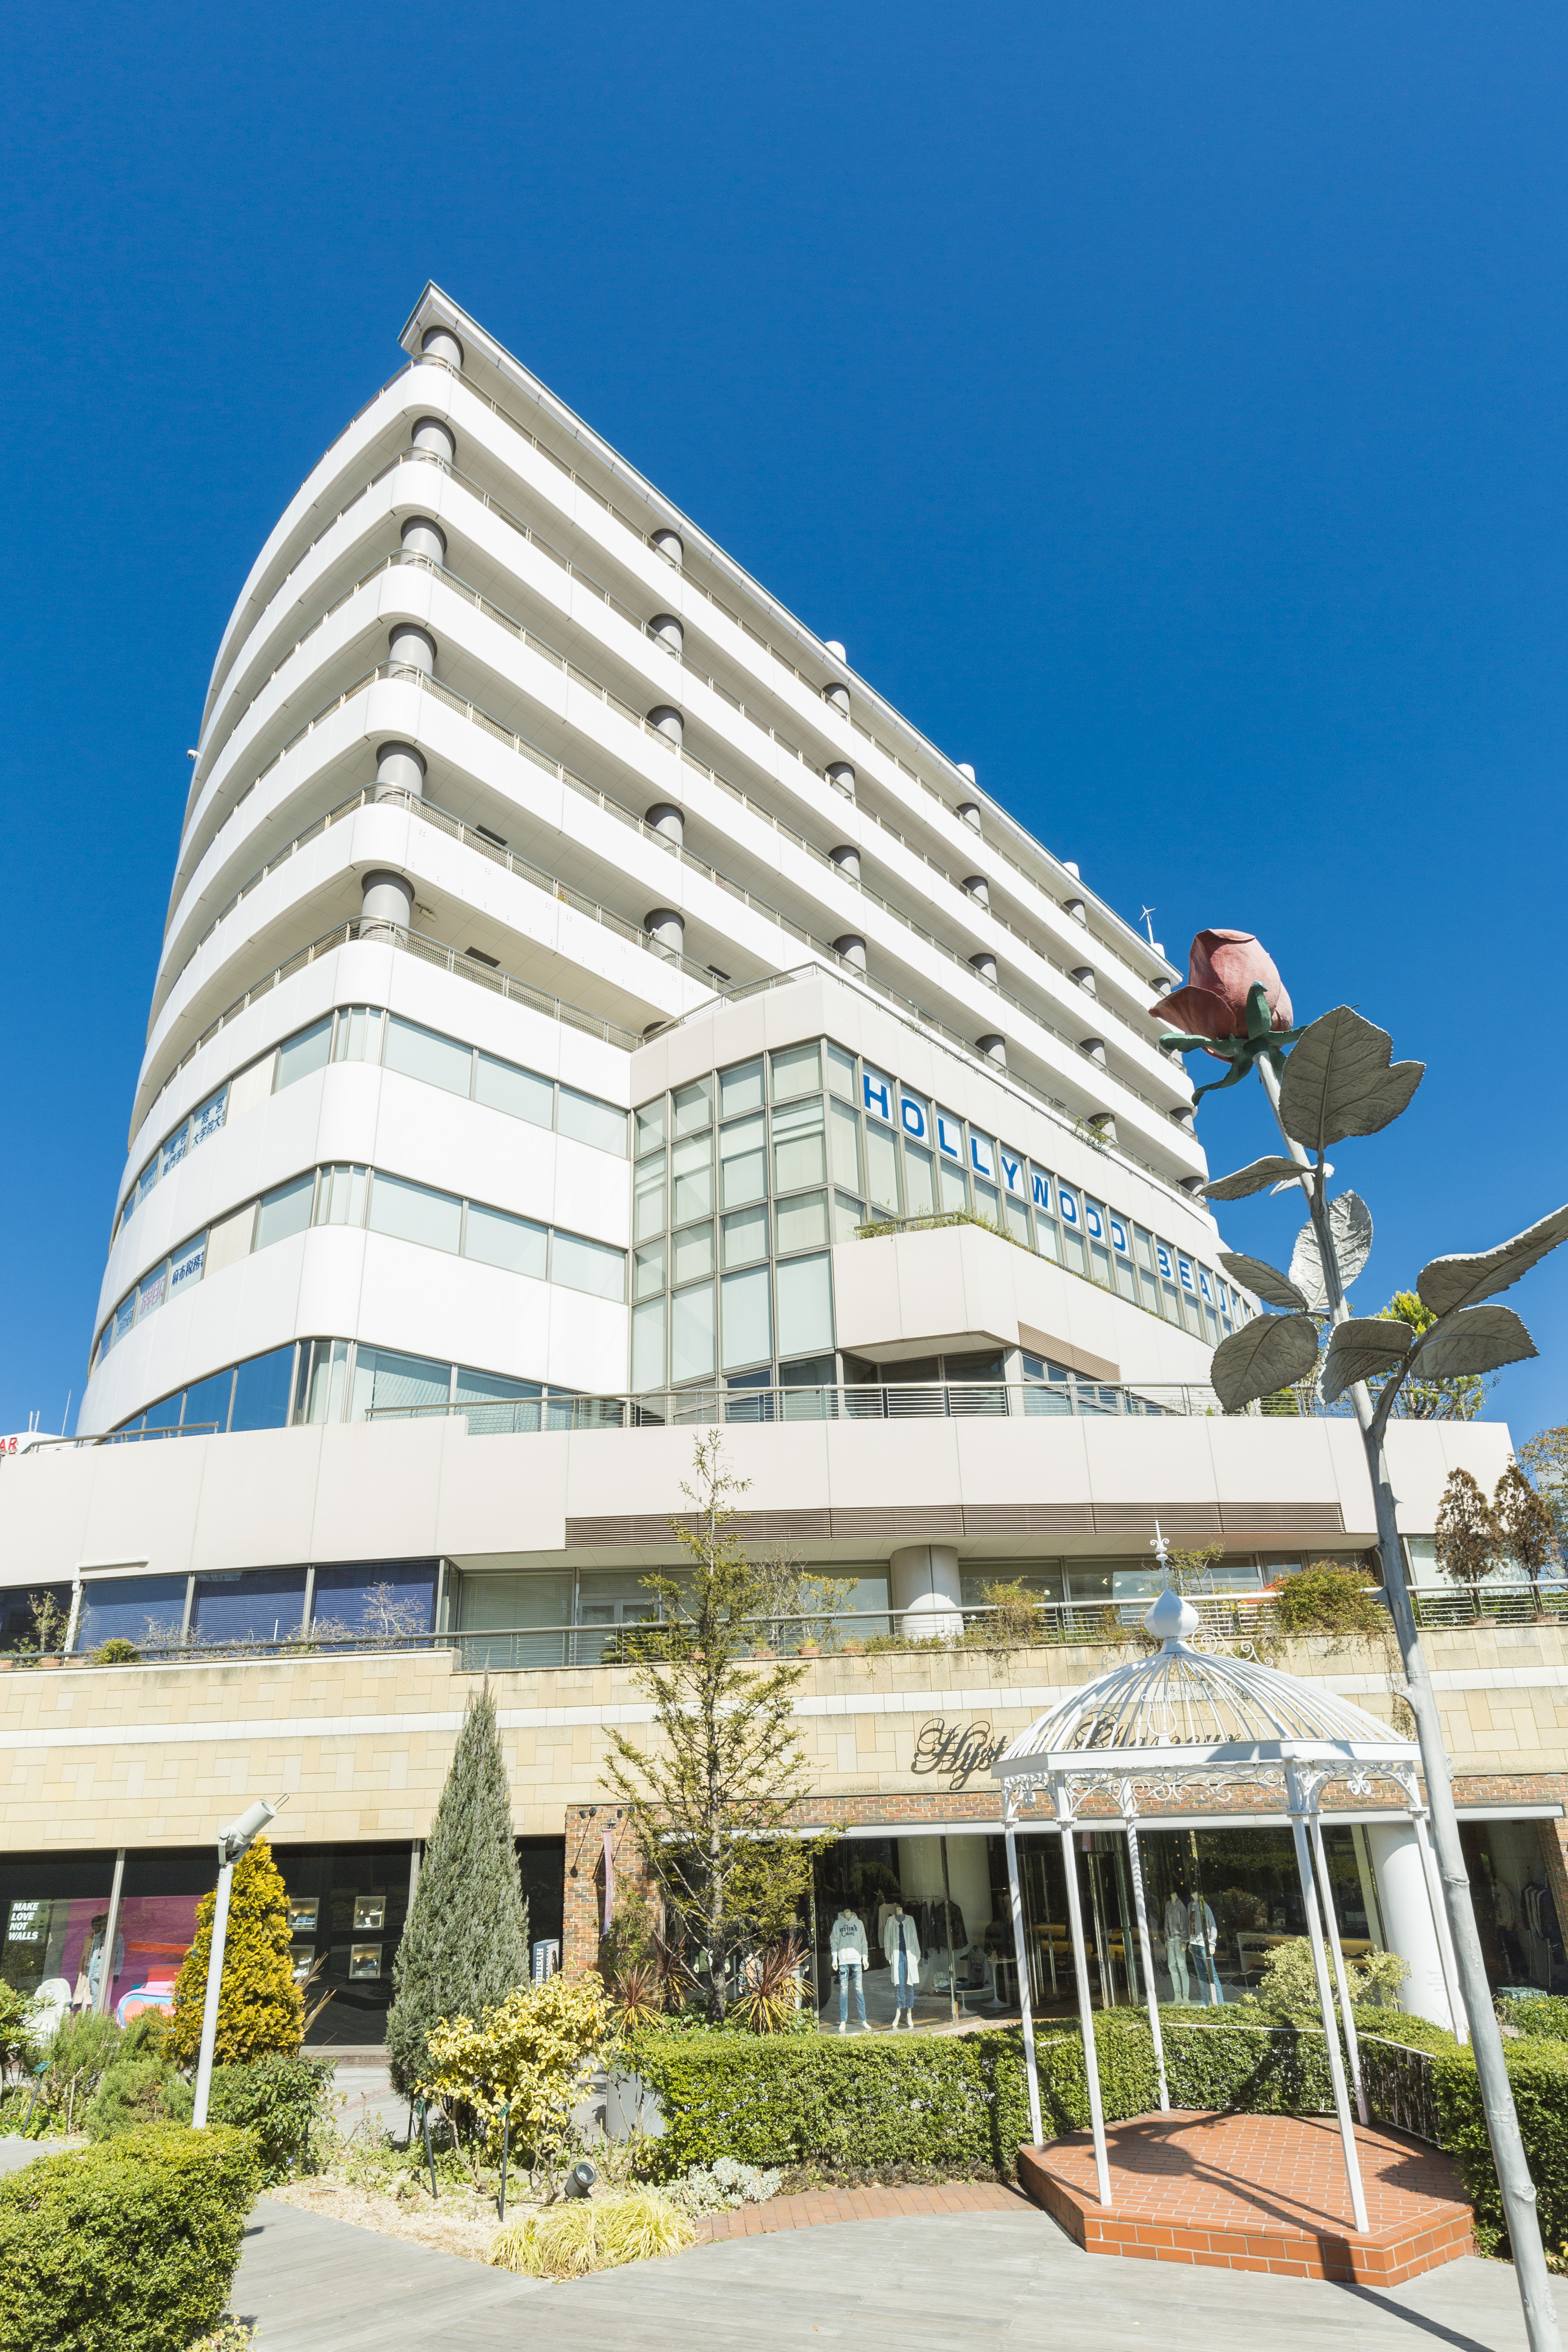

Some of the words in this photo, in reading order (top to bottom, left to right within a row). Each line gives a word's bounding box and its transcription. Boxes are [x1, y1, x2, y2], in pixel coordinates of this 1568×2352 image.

[863, 1074, 1126, 1252] HOLLYWOOD
[1158, 1247, 1247, 1315] BEAU
[914, 1718, 1048, 1791] Hyst
[12, 1902, 40, 1911] MAKE
[10, 1912, 35, 1921] LOVE
[9, 1922, 29, 1931] NOT
[8, 1931, 39, 1941] WALLS
[535, 1947, 544, 1991] HYSTER
